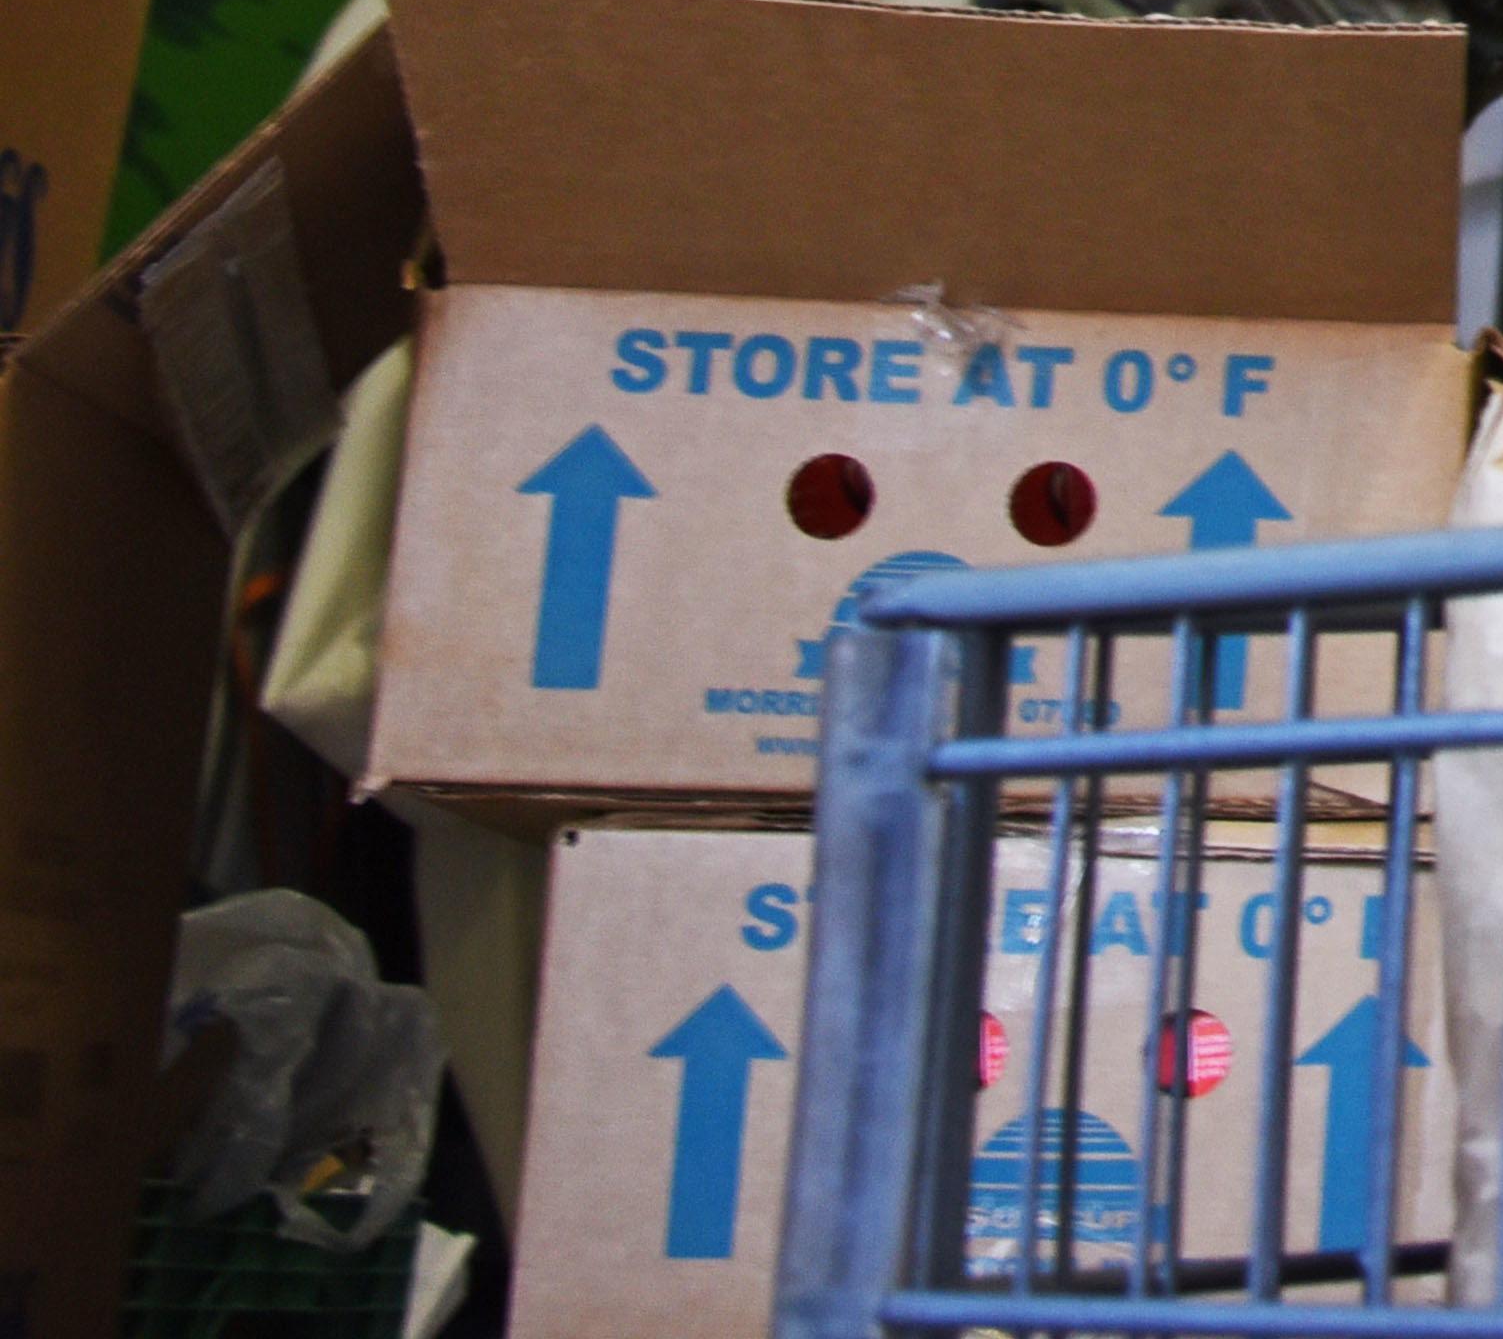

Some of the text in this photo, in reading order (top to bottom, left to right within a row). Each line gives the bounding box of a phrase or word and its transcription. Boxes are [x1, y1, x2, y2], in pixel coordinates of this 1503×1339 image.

[610, 328, 924, 406] STORE
[952, 343, 1075, 411] AT
[1221, 354, 1276, 417] F
